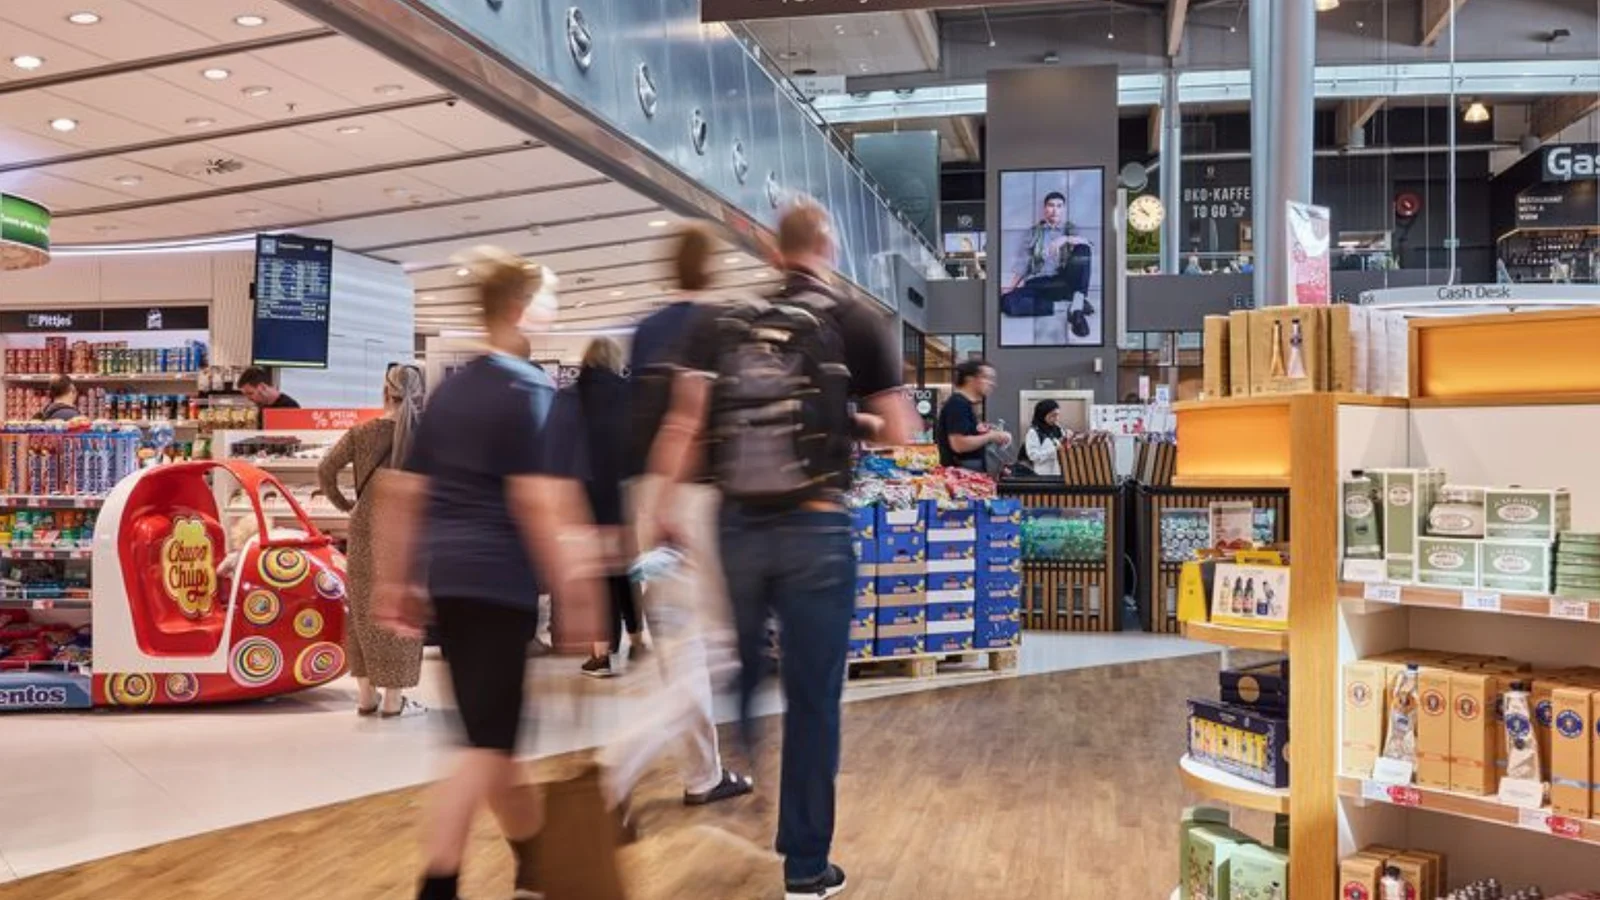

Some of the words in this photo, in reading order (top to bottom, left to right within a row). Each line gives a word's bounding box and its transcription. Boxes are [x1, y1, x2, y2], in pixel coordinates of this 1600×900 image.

[1192, 204, 1208, 218] TO
[1211, 204, 1227, 218] GO
[1437, 286, 1472, 300] Cash
[1475, 284, 1511, 299] Desk
[168, 540, 208, 562] Chupa
[169, 564, 210, 603] Chups
[0, 684, 66, 704] entos
